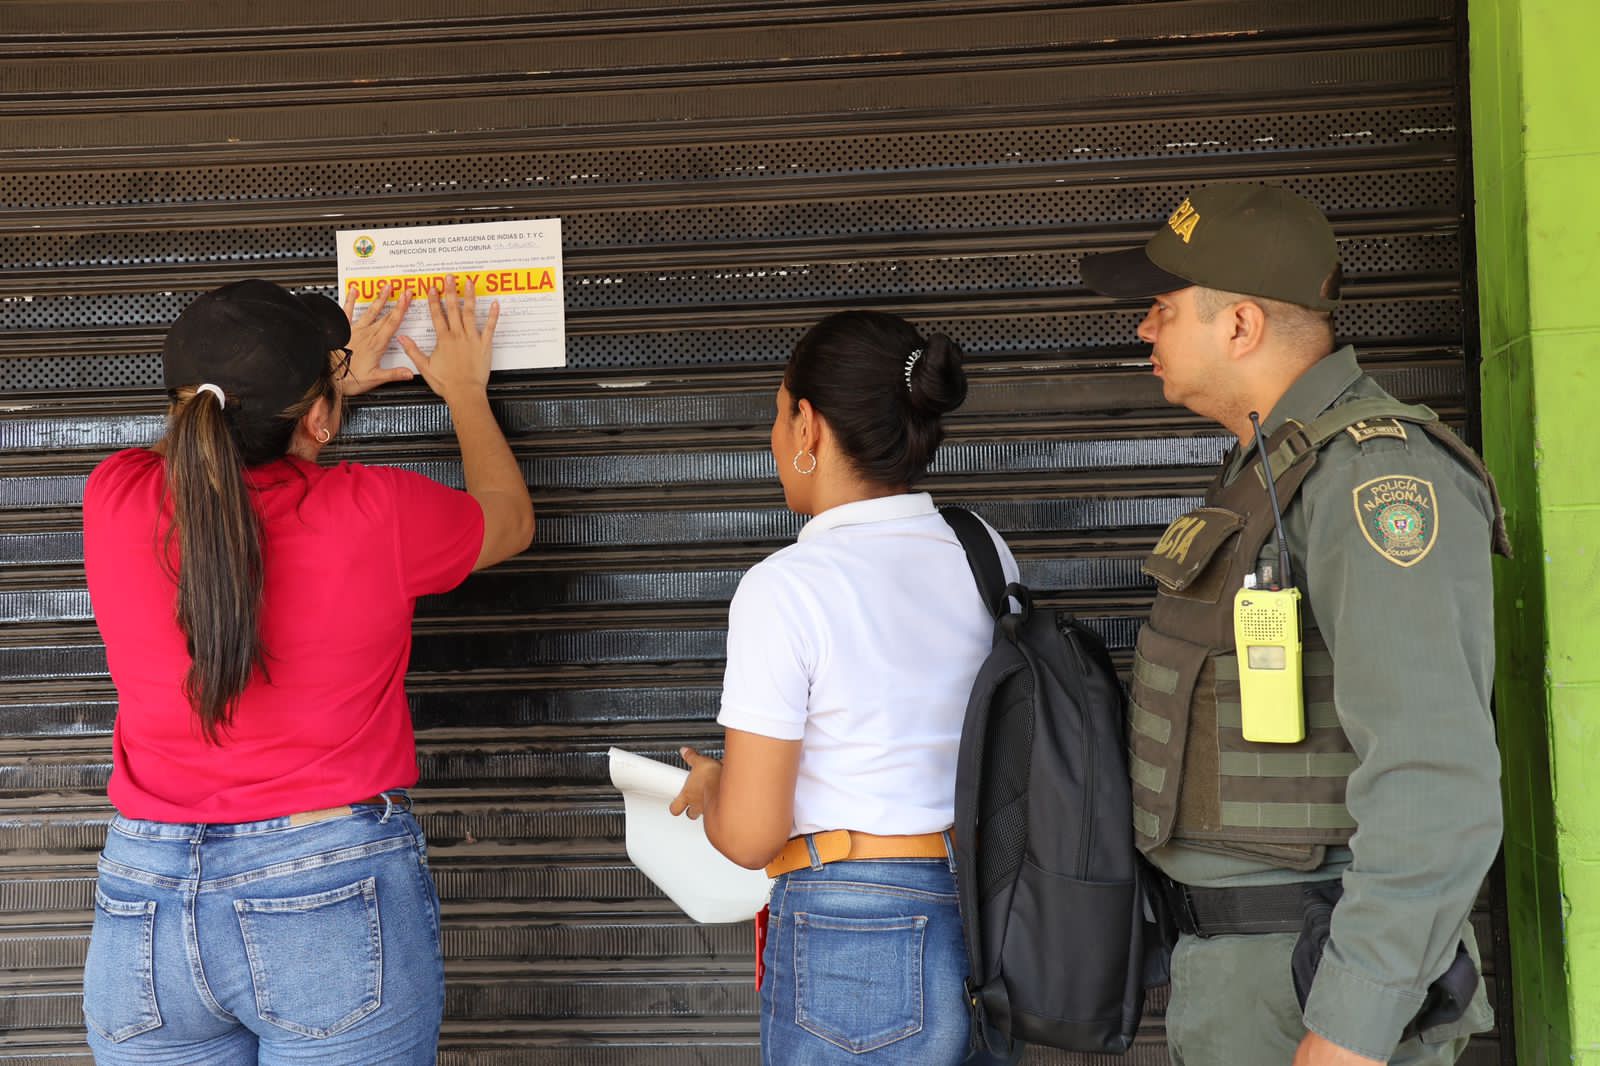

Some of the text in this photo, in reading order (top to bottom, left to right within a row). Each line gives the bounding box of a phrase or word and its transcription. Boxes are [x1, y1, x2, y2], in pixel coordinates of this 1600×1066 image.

[414, 237, 437, 245] MAYOR
[437, 236, 447, 244] DE
[447, 235, 486, 243] CARTAGENA
[497, 233, 518, 241] INDIAS
[428, 246, 438, 254] DE
[463, 244, 492, 252] COMUNA
[485, 270, 554, 293] SELLA
[1370, 480, 1418, 496] POLICÍA
[1363, 490, 1430, 512] NACIONAL
